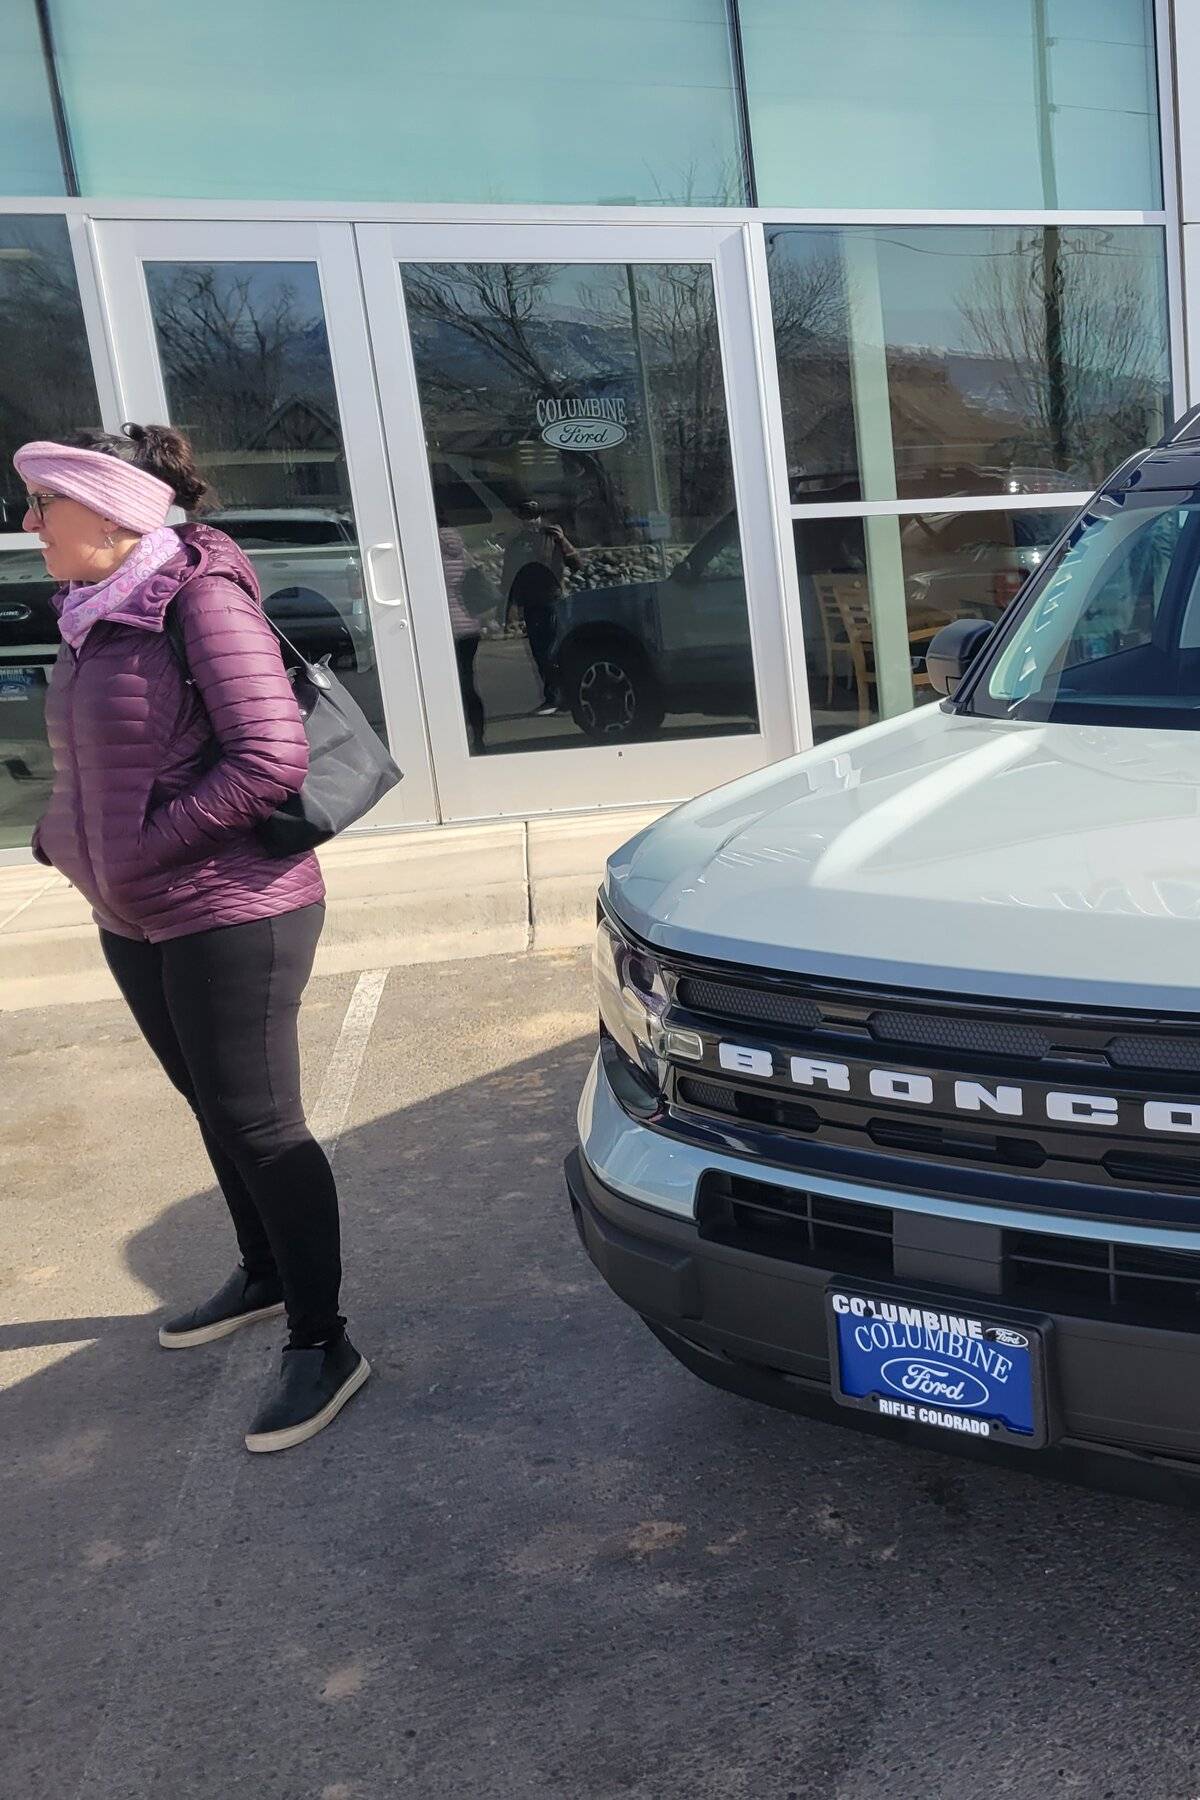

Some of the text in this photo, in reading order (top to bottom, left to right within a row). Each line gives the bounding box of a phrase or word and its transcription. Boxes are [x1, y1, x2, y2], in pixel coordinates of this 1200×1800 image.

[536, 398, 628, 427] COLUMBINE
[559, 423, 608, 444] Ford
[832, 1294, 984, 1341] COLUMBINE
[854, 1322, 1013, 1384] COLUMBINE
[901, 1363, 965, 1401] Ford
[879, 1399, 990, 1437] RIFLE COLORADO
